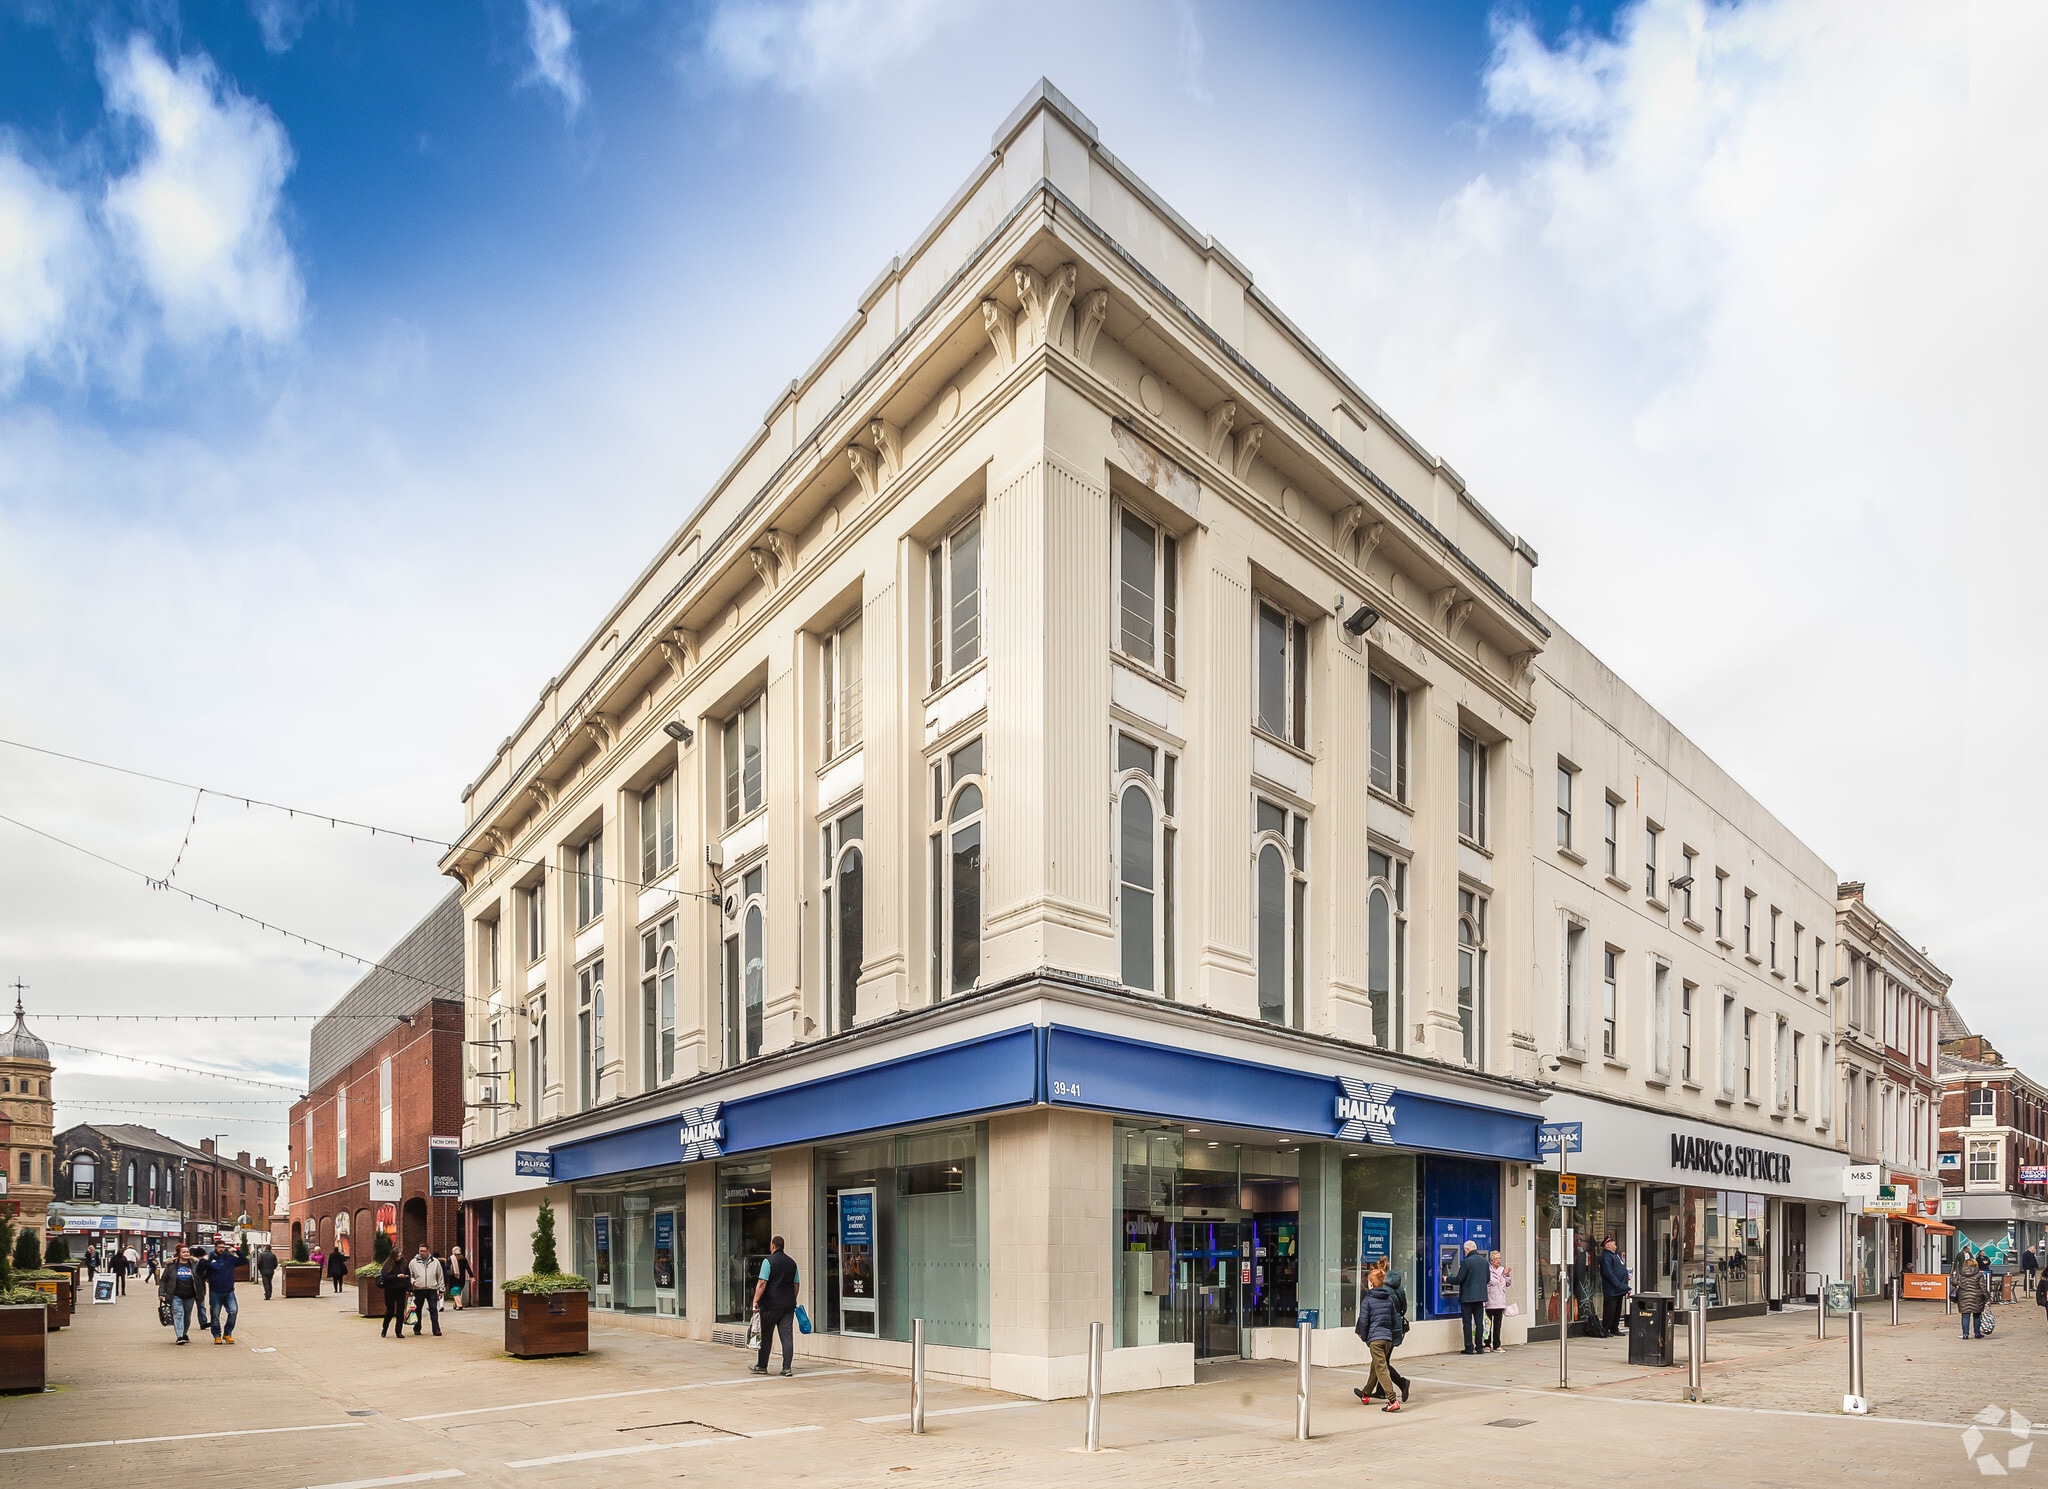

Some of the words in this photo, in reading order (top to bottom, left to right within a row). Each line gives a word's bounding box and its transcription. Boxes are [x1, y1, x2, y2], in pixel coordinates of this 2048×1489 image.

[1053, 1081, 1080, 1097] 39-41
[1338, 1097, 1396, 1125] HALIFAX
[680, 1120, 721, 1146] HALIFAX
[1539, 1133, 1579, 1142] HALIFAX
[517, 1160, 550, 1168] HALIFAX
[1851, 1172, 1873, 1180] M&S
[376, 1179, 395, 1187] M&S
